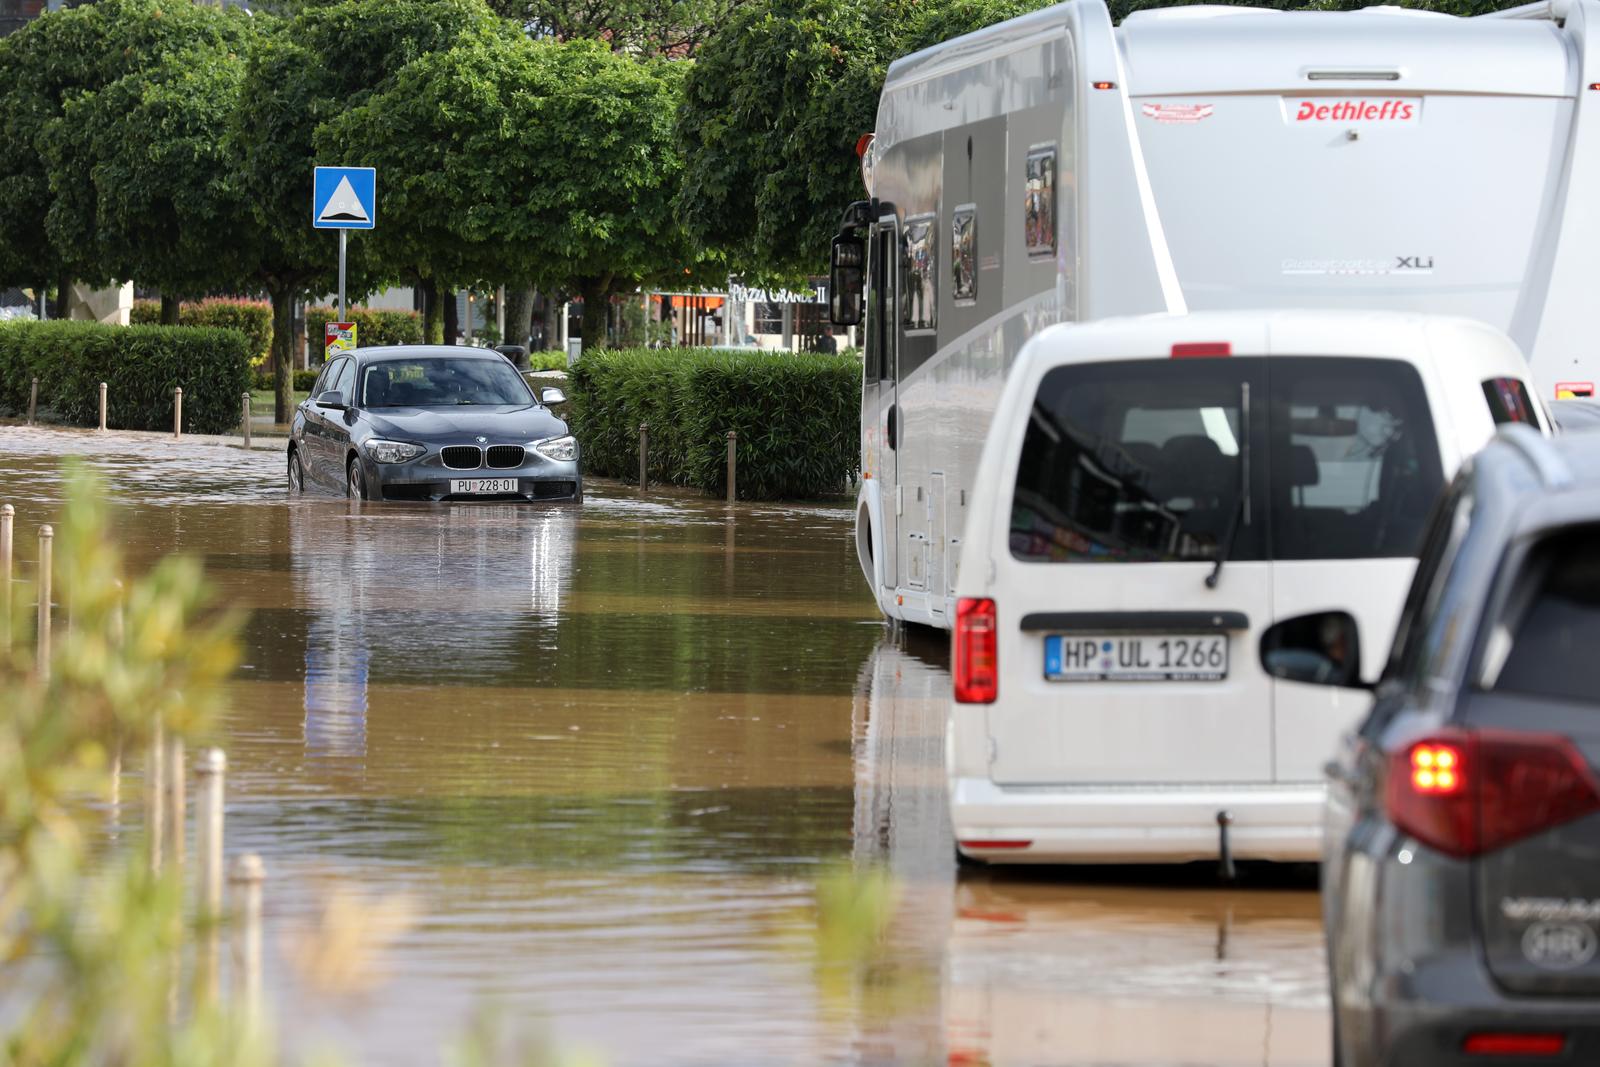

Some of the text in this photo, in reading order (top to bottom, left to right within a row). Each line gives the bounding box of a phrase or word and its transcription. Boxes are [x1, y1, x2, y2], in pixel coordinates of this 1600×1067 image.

[1296, 100, 1413, 120] Dethleffs
[1397, 256, 1433, 268] XLi
[732, 284, 768, 303] PIAZZA
[817, 286, 826, 303] II
[458, 480, 471, 491] PU
[1065, 640, 1223, 668] HP UL 1266
